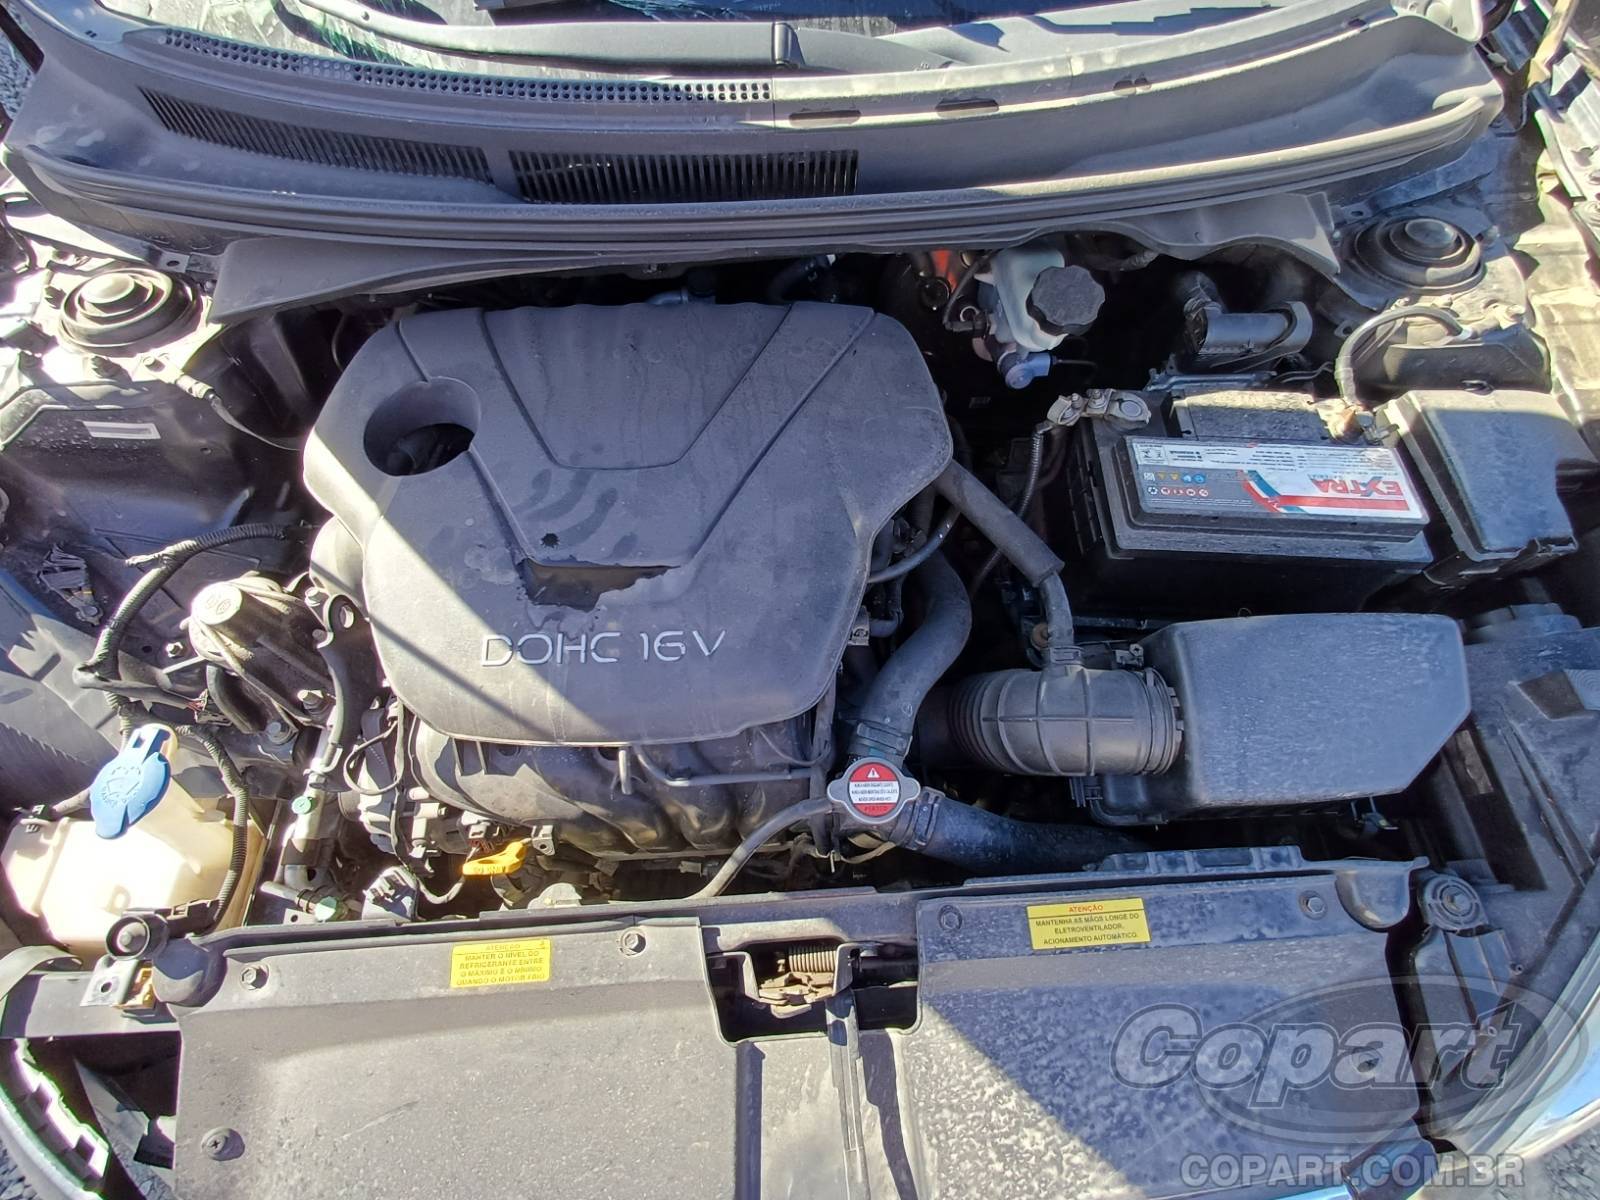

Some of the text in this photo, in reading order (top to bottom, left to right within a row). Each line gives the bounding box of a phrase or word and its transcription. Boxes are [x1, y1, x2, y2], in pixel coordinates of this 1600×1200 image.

[1309, 475, 1404, 497] EXTRA
[480, 630, 727, 667] DOHC 16V
[1068, 904, 1104, 913] ATENÇÃO
[1035, 917, 1073, 927] MANTENHA
[1104, 912, 1128, 921] LONGE
[1129, 912, 1140, 920] DO
[1043, 935, 1093, 946] ACIONAMENTO
[464, 954, 496, 962] MANTER
[460, 970, 466, 978] O
[490, 976, 497, 984] O
